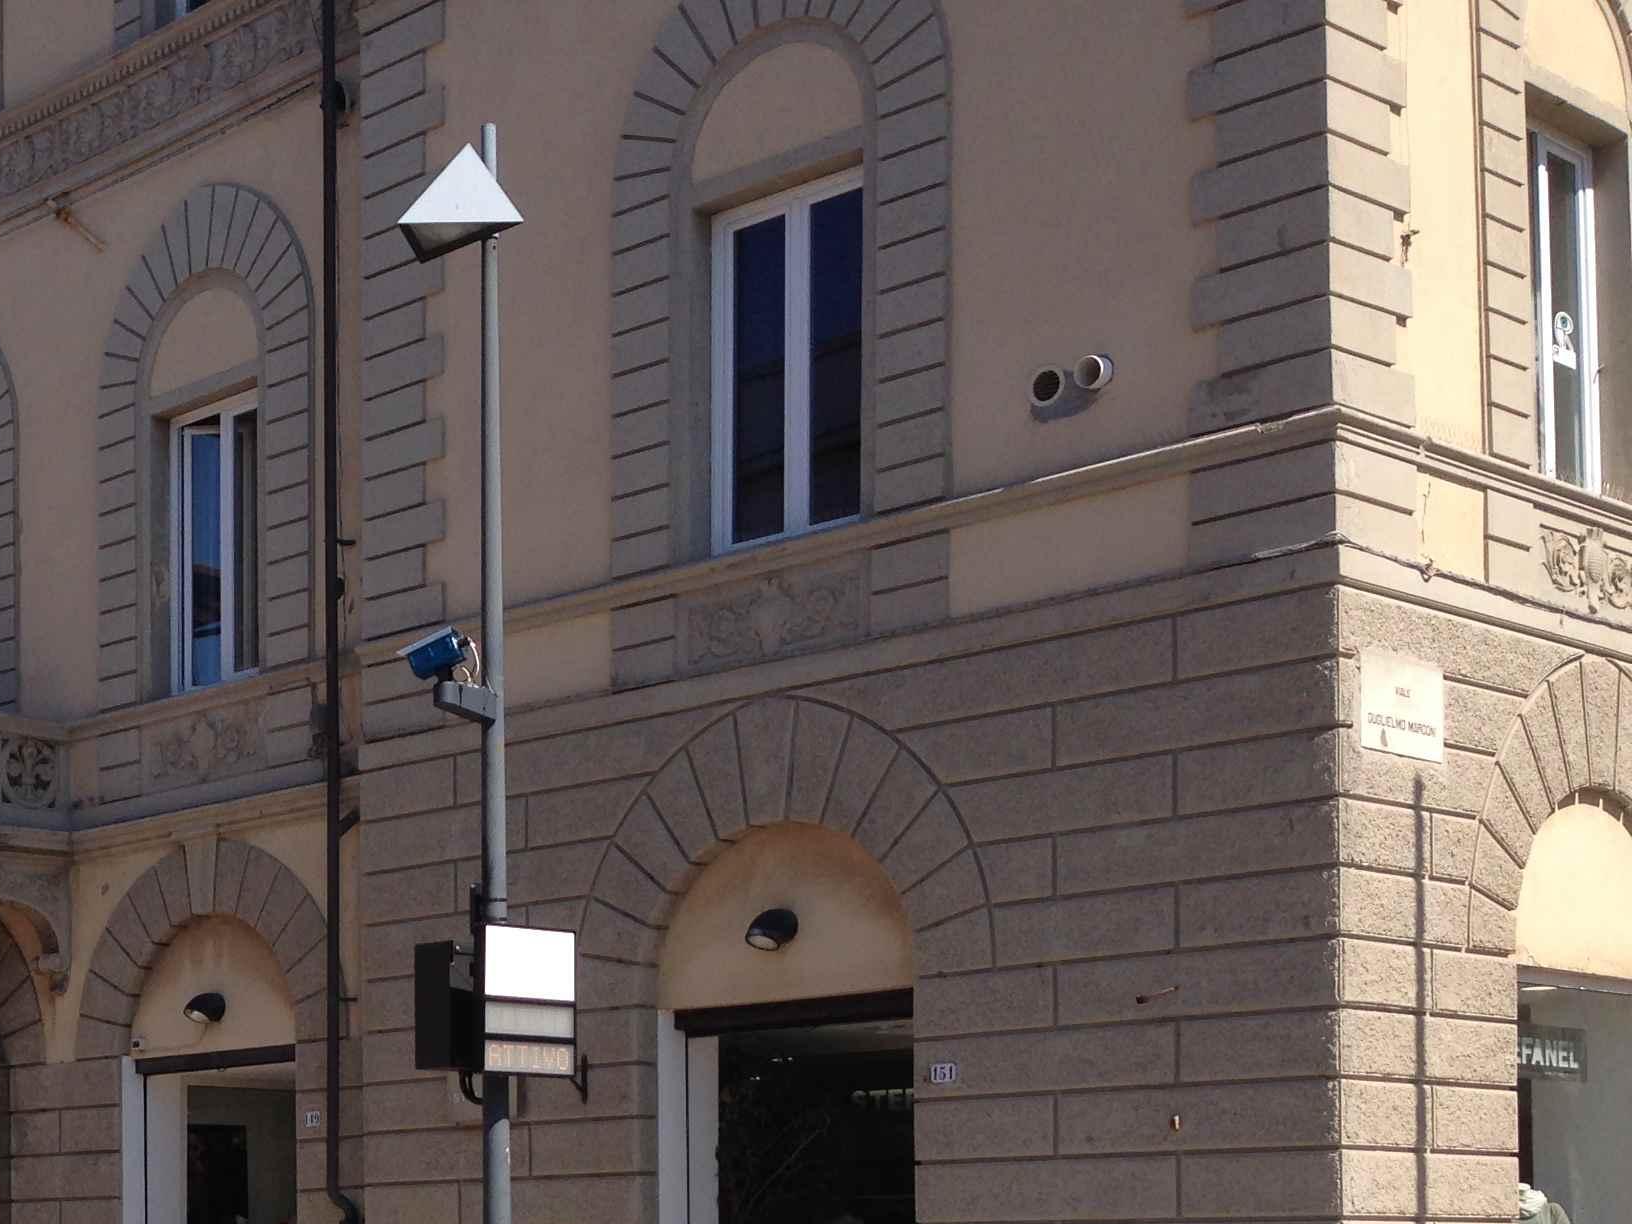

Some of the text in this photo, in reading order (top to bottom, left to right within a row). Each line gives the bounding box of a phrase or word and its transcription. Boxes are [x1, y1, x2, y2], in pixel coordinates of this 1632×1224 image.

[488, 1043, 569, 1071] ATTIVO
[1518, 1037, 1580, 1069] FANEL
[932, 1065, 955, 1082] 151
